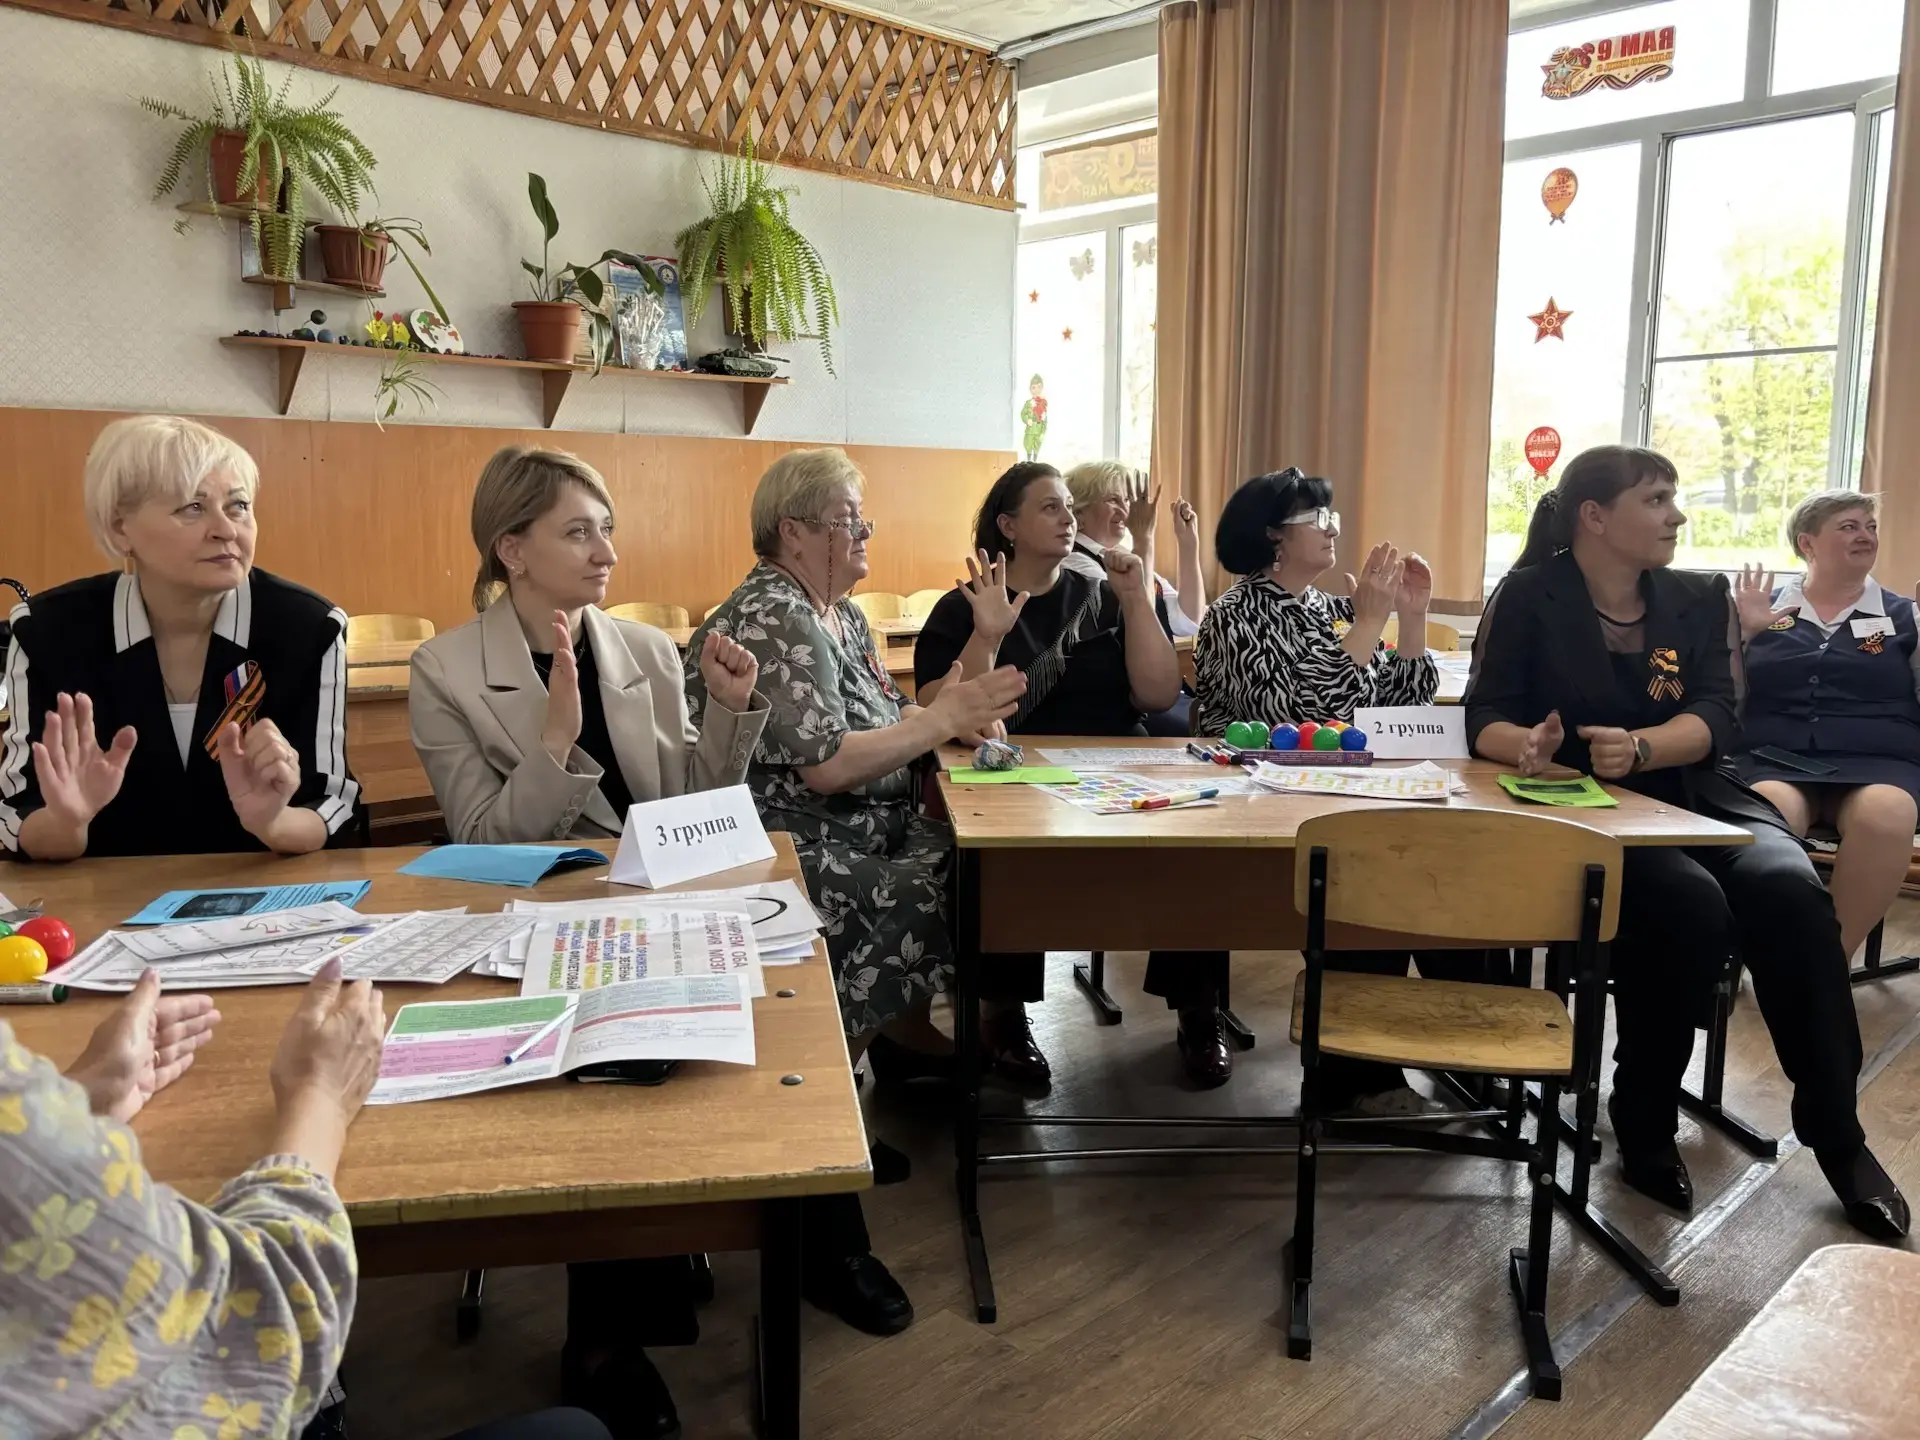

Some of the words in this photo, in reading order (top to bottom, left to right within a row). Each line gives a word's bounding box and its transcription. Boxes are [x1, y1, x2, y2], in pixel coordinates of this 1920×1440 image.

[1597, 38, 1612, 61] 9
[1620, 26, 1674, 57] МАЯ
[1373, 721, 1384, 734] 2
[1388, 722, 1445, 737] группа
[655, 824, 668, 846] 3
[672, 815, 738, 846] группа
[565, 950, 580, 990] ФИОЛЕТОВЫЙ
[600, 961, 614, 986] КРАСНЫ
[636, 946, 648, 979] ОРАНЖЕВЫ
[731, 951, 748, 968] ОБА
